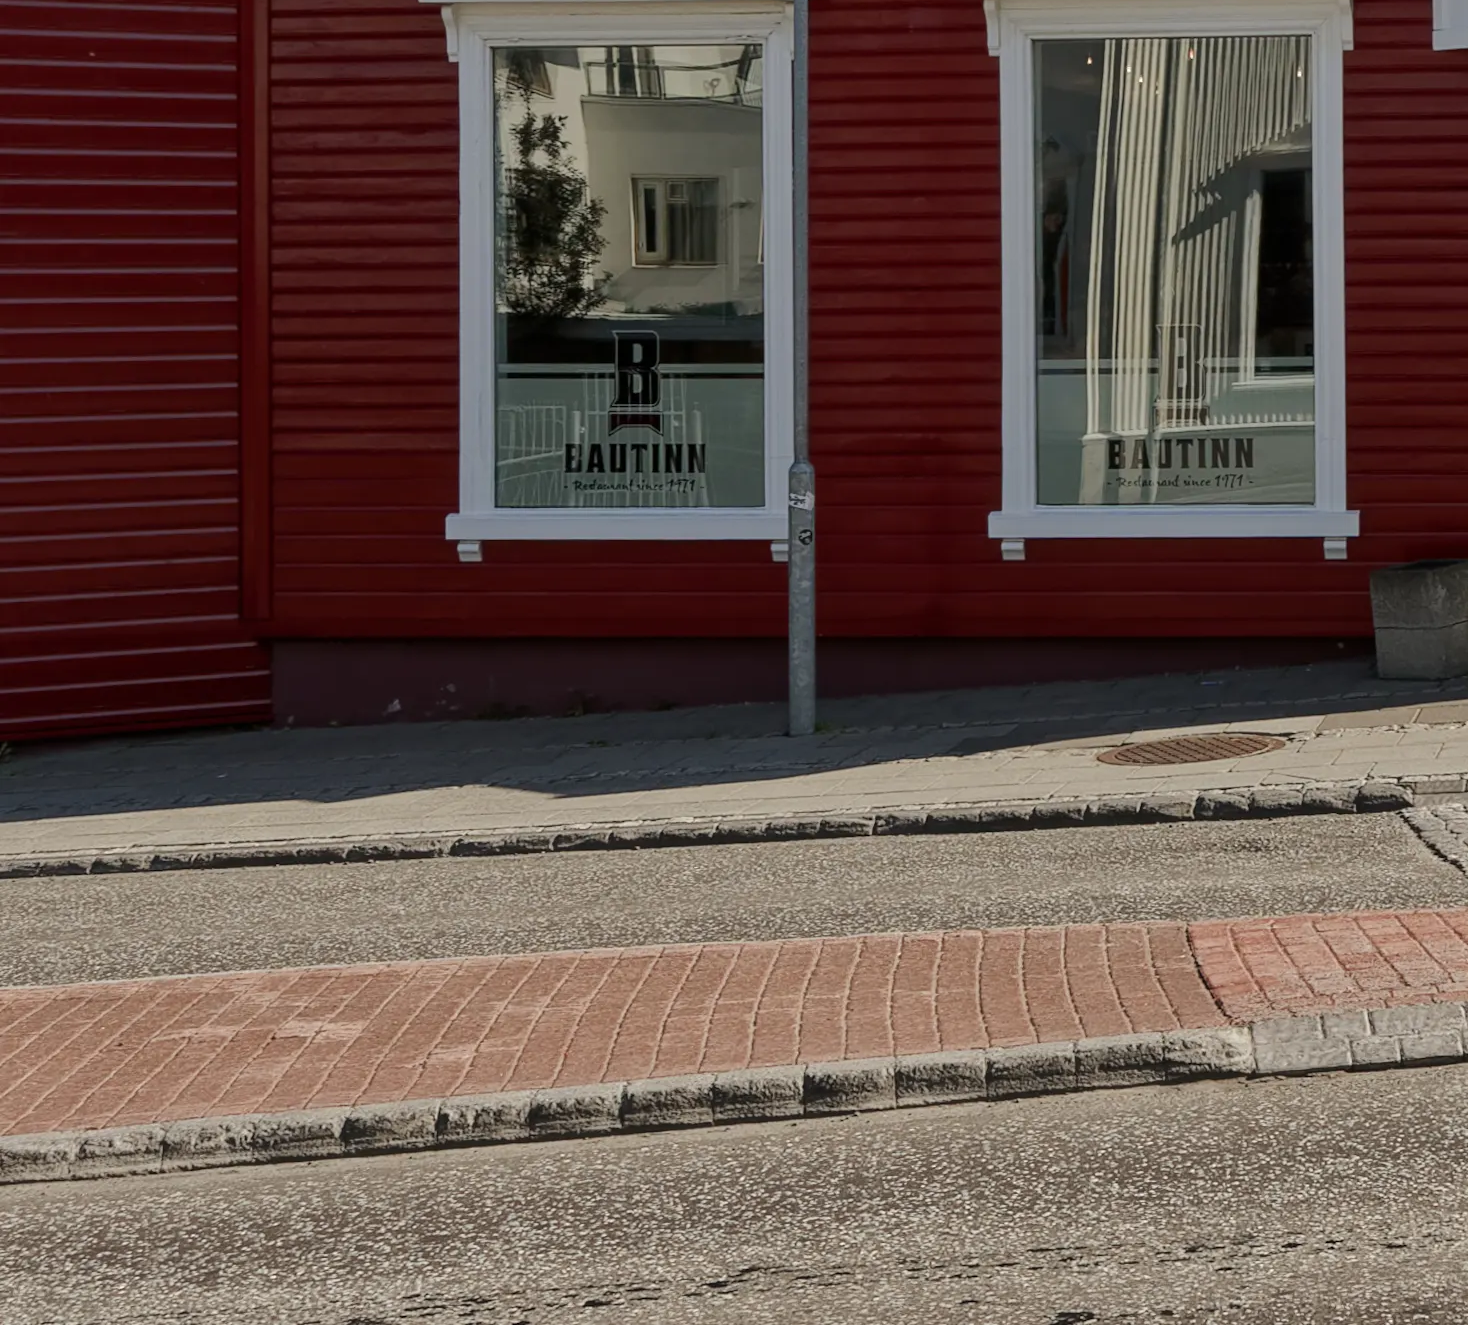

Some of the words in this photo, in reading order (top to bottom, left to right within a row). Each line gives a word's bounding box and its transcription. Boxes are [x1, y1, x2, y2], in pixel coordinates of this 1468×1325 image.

[611, 329, 661, 408] B
[564, 443, 706, 474] BAUTINN
[1107, 438, 1254, 470] BAUTINN
[1183, 475, 1211, 488] since
[1214, 473, 1244, 489] 1971
